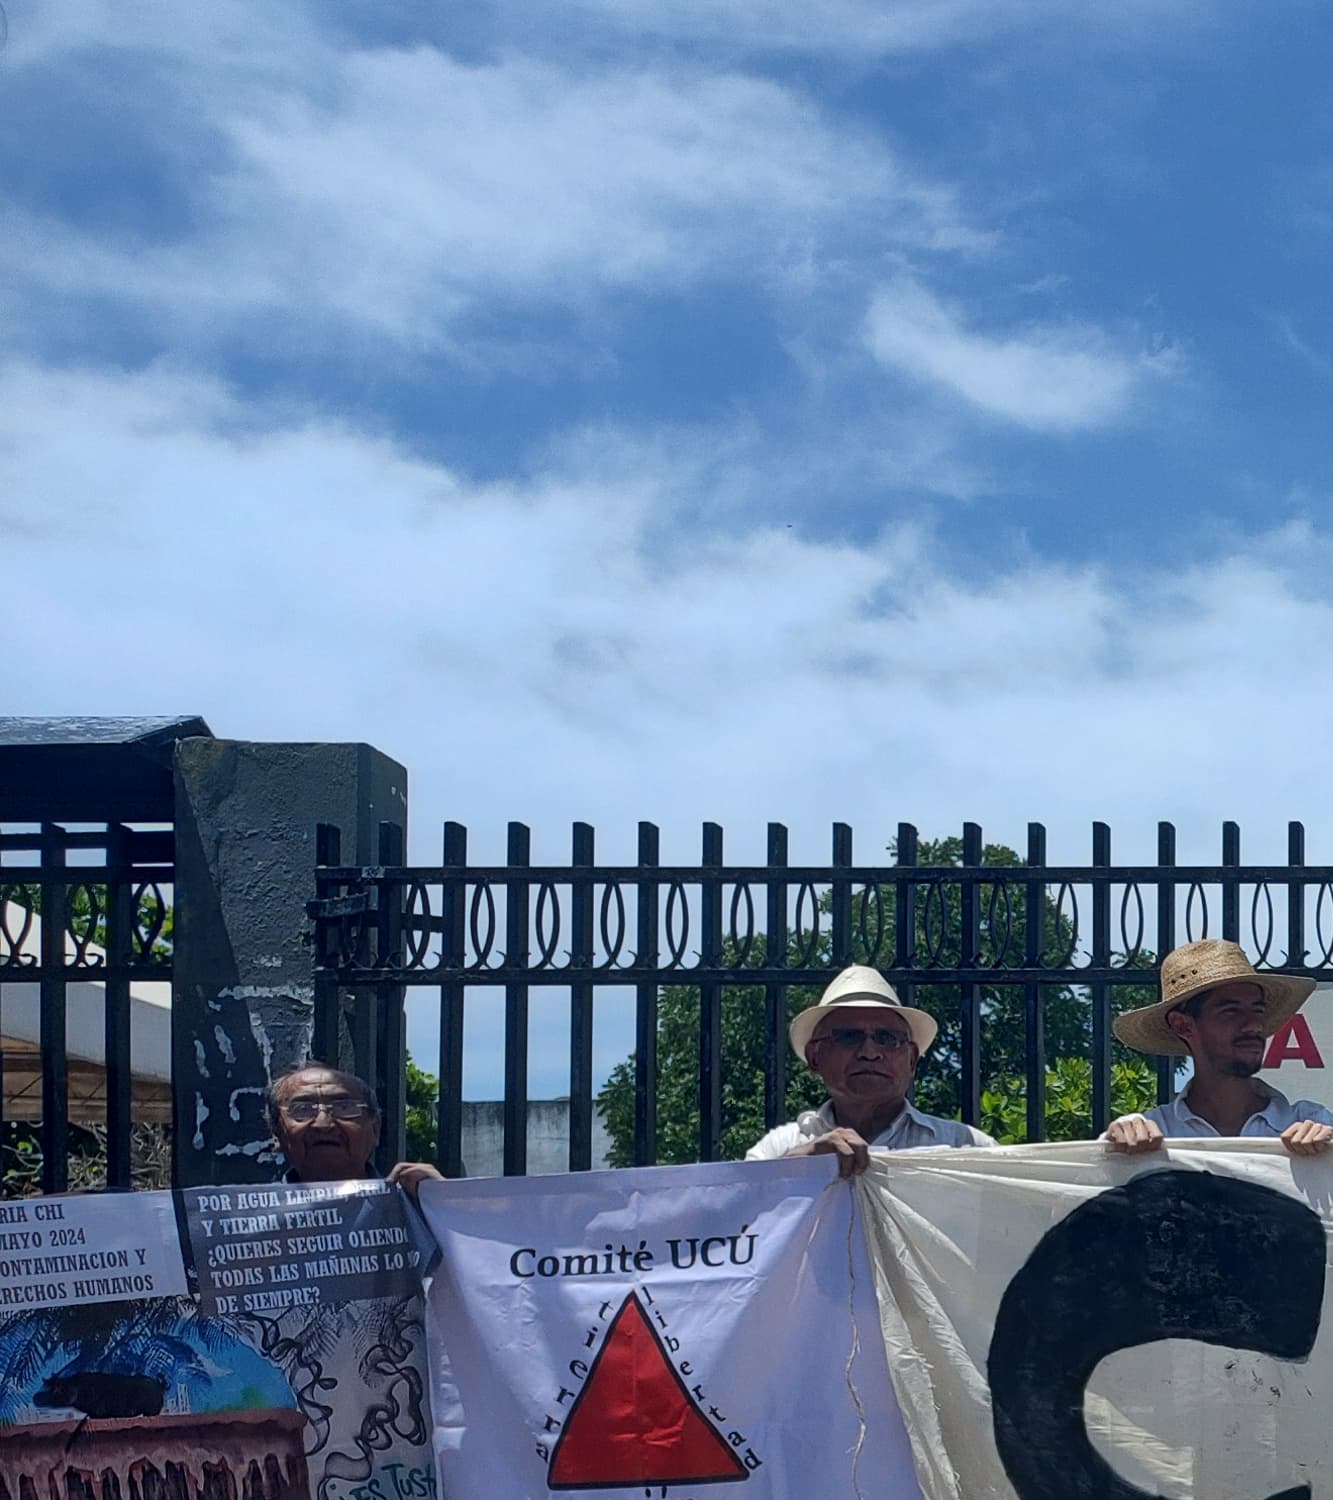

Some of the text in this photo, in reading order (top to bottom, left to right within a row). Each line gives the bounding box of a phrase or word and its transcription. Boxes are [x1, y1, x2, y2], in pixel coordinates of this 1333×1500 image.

[35, 1204, 64, 1221] CHI
[198, 1195, 232, 1213] POR
[238, 1192, 280, 1210] AGUA
[50, 1227, 86, 1248] 2024
[201, 1208, 343, 1238] Y TIERRA FERTIL
[134, 1248, 147, 1266] Y
[207, 1240, 282, 1268] ¿QUIERES
[287, 1233, 344, 1255] SEGUIR
[510, 1225, 759, 1278] Comité UCÚ
[211, 1268, 264, 1289] TODAS
[269, 1264, 300, 1284] LAS
[304, 1256, 379, 1279] MAÑANAS
[384, 1253, 404, 1270] LO
[0, 1274, 153, 1304] RECHOS HUMANOS
[217, 1286, 320, 1315] DE SIEMPRE?
